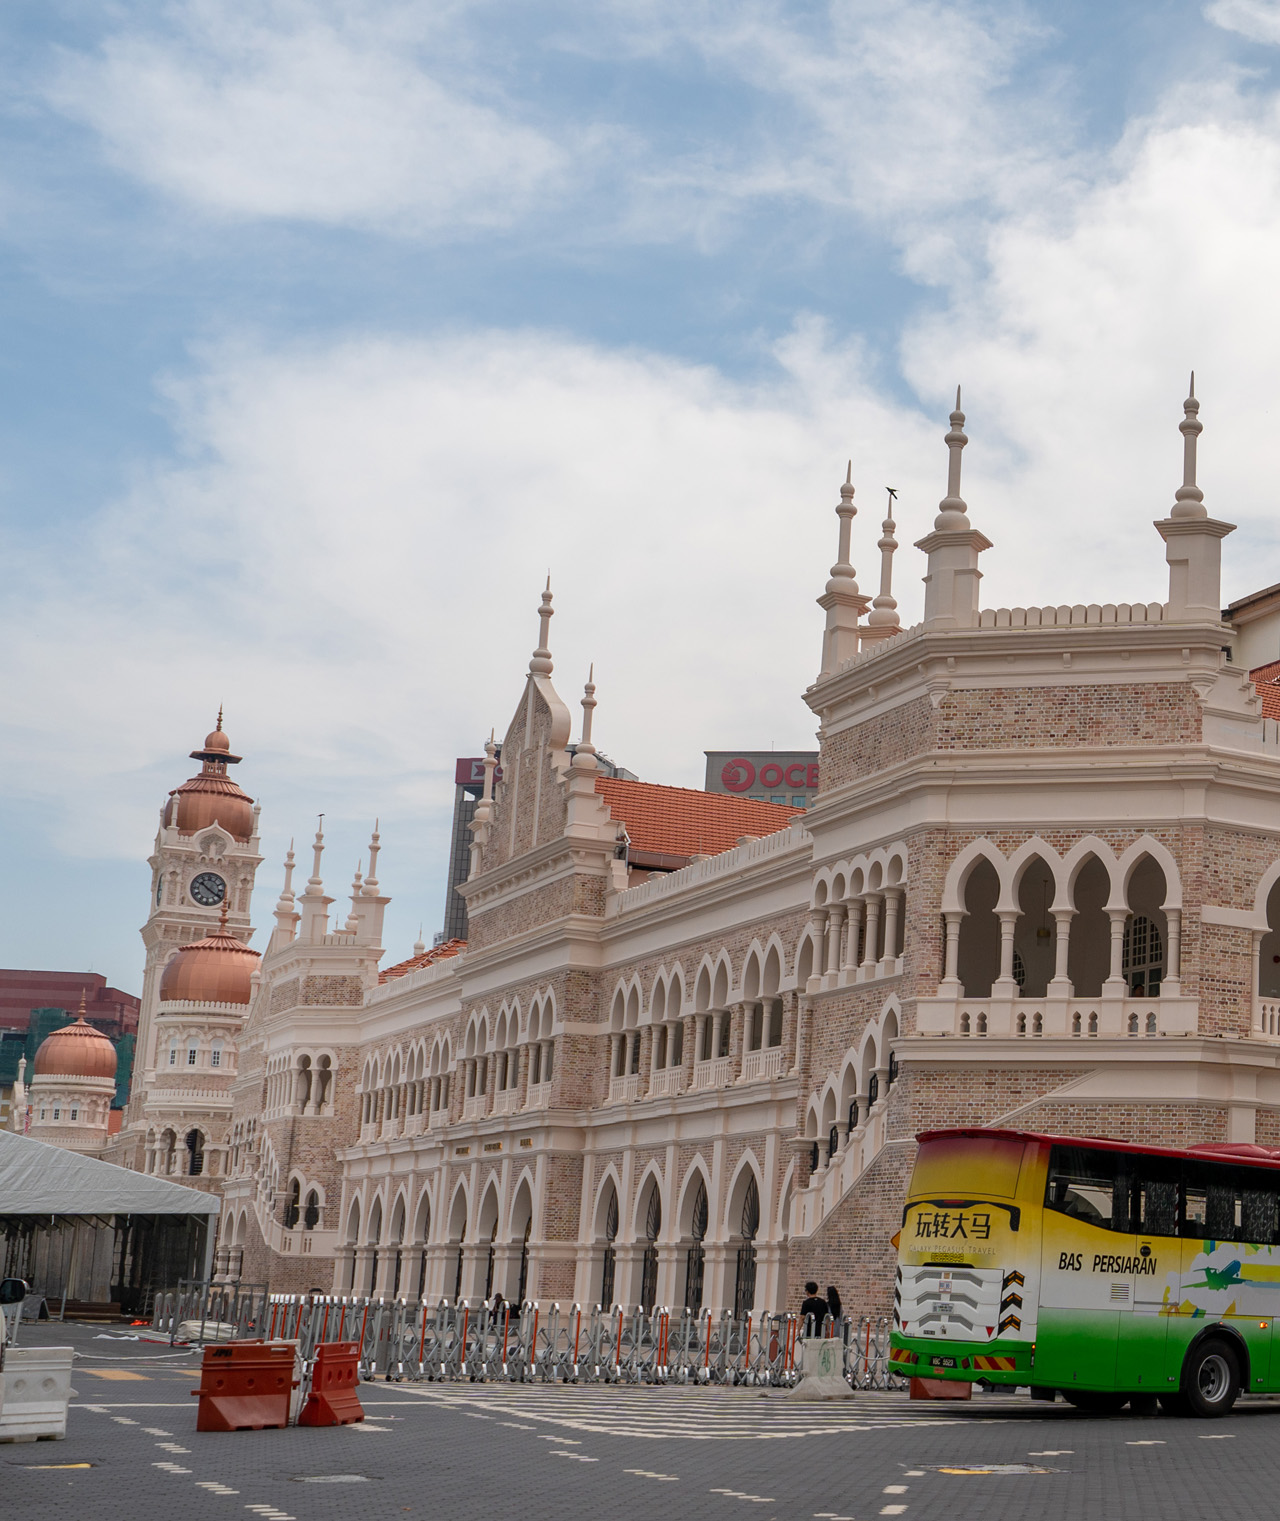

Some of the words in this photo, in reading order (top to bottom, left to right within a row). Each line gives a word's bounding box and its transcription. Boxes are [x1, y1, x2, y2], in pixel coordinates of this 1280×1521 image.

[915, 1212, 990, 1239] 玩转大马
[935, 1245, 964, 1253] PEGASUS
[968, 1246, 996, 1255] TRAVEL
[1058, 1252, 1083, 1271] BAS
[1092, 1254, 1157, 1275] PERSIARAN
